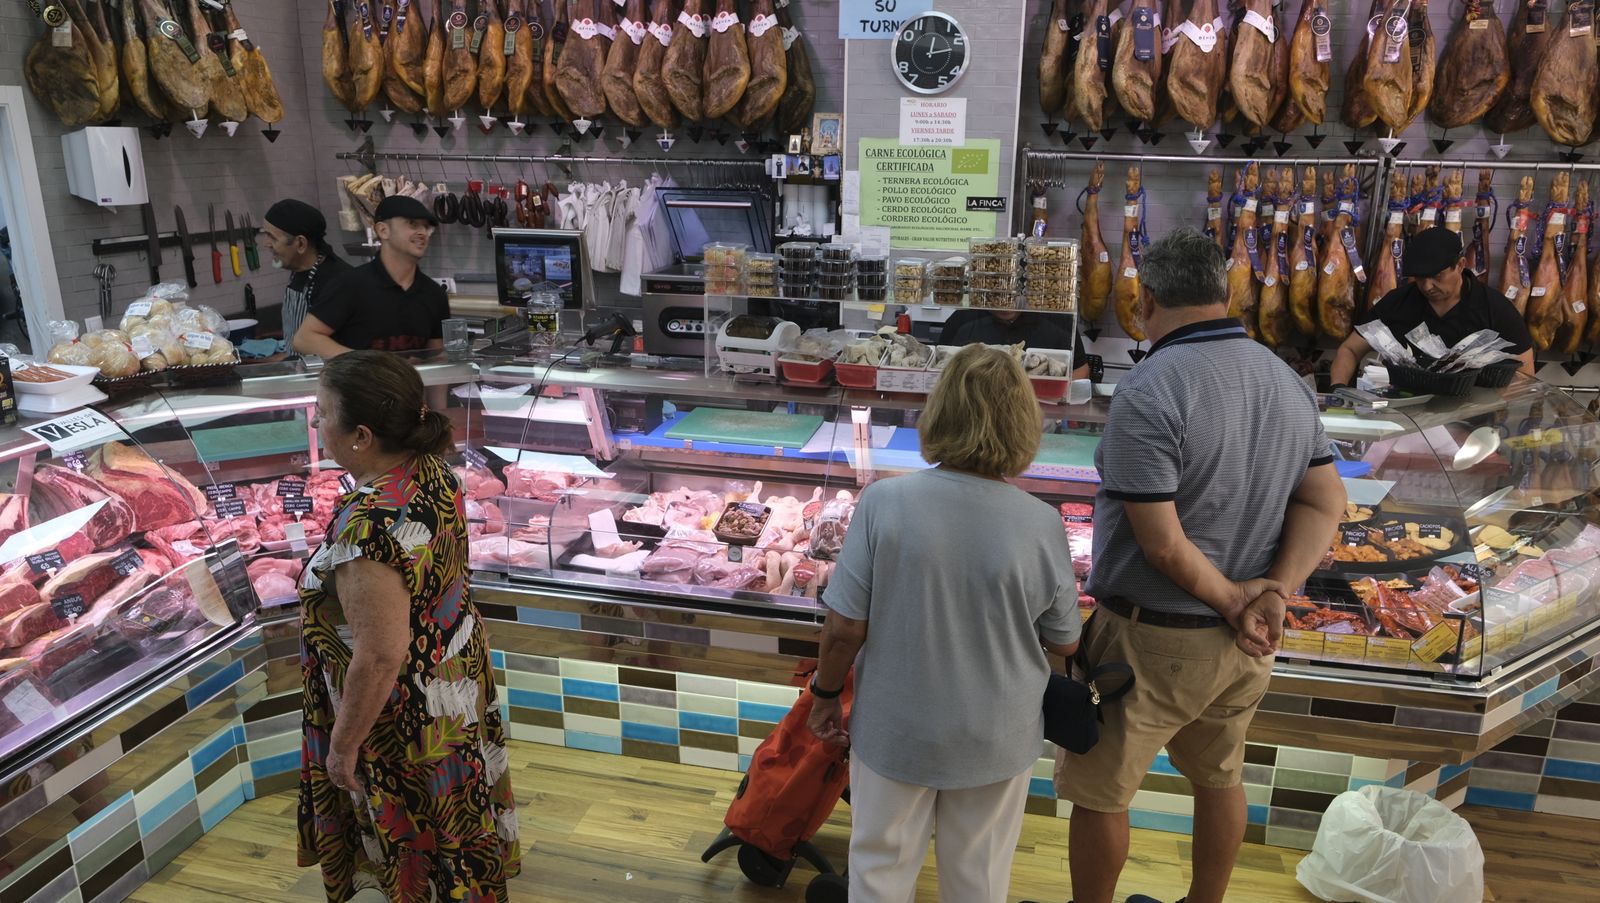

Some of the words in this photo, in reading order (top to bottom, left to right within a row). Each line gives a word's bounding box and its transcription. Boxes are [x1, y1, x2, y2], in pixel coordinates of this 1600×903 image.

[875, 0, 896, 12] SU
[899, 62, 908, 73] 8
[909, 74, 918, 85] 7
[865, 148, 895, 159] CARNE
[897, 147, 947, 160] ECOLÓGICA
[876, 162, 934, 173] CERTIFICADA
[883, 177, 921, 185] TERNERA
[923, 176, 969, 186] ECOLÓGICA
[911, 186, 956, 195] ECOLÓGICO
[904, 195, 950, 204] ECOLÓGICO
[980, 199, 1003, 207] FINCA
[911, 205, 957, 214] ECOLÓGICO
[881, 215, 919, 223] CORDERO
[922, 214, 967, 224] ECOLÓGICO
[65, 417, 107, 434] ESLA
